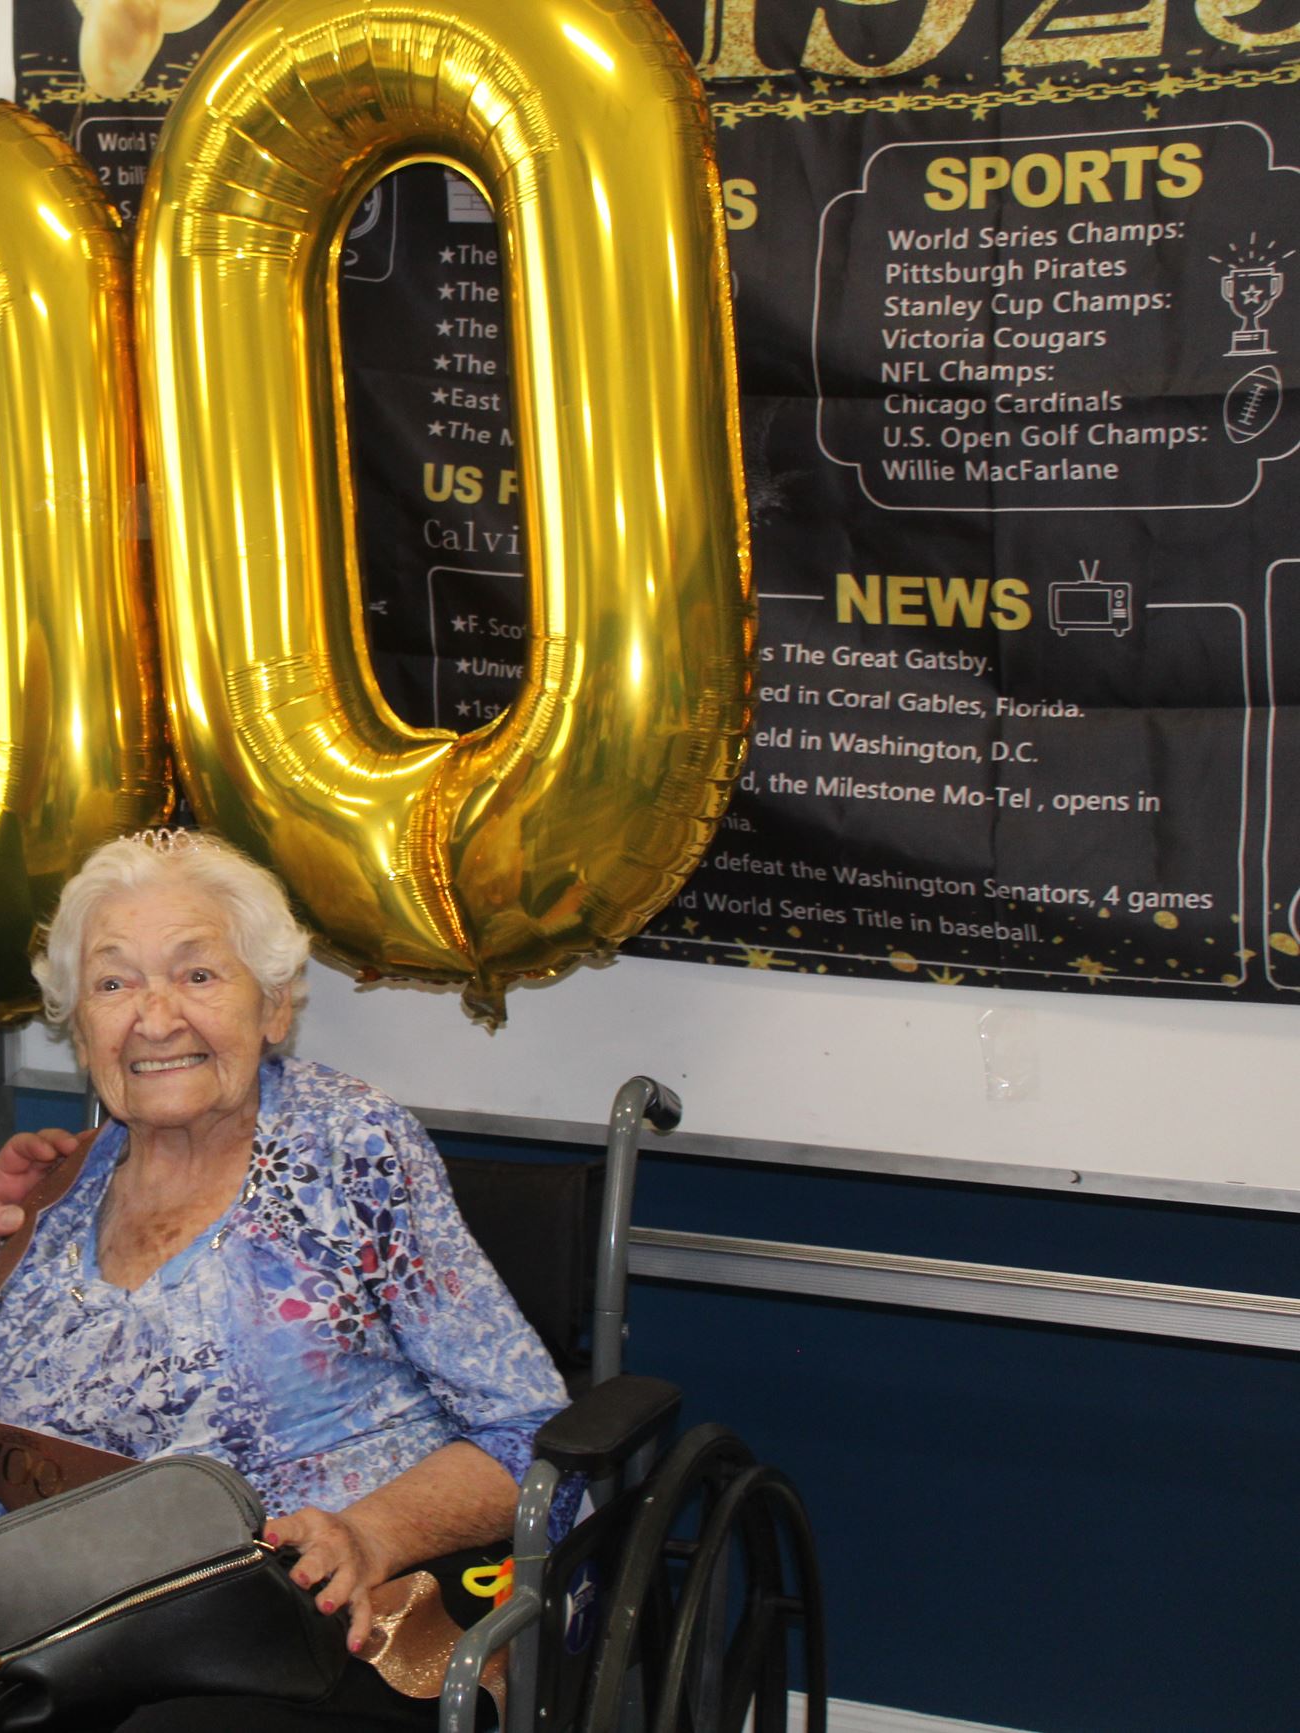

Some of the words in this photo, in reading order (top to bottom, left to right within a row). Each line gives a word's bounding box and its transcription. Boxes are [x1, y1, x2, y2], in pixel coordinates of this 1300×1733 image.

[97, 132, 147, 152] World
[924, 143, 1203, 211] SPORTS
[887, 227, 969, 251] World
[978, 225, 1058, 249] Series
[1067, 219, 1185, 247] Champs:
[457, 245, 498, 266] The
[885, 261, 1024, 287] Pittsburgh
[1034, 258, 1128, 281] Pirates
[457, 281, 500, 303] The
[883, 295, 983, 322] Stanley
[991, 293, 1044, 320] Cup
[1052, 290, 1172, 319] Champs:
[455, 317, 499, 339] The
[881, 328, 985, 350] Victoria
[993, 327, 1107, 353] Cougars
[453, 353, 497, 375] The
[880, 361, 931, 383] NFL
[939, 360, 1055, 387] Champs:
[450, 388, 501, 412] East
[883, 393, 987, 420] Chicago
[994, 390, 1123, 415] Cardinals
[447, 420, 492, 444] The
[882, 426, 931, 448] U.S.
[940, 426, 1011, 453] Open
[1020, 424, 1079, 448] Golf
[1087, 423, 1209, 450] Champs:
[422, 462, 483, 505] US
[881, 459, 956, 482] Willie
[964, 459, 1120, 482] MacFarlane
[835, 572, 1033, 632] NEWS
[488, 617, 527, 640] Sco
[781, 643, 826, 666] The
[831, 645, 899, 669] Great
[904, 649, 995, 677] Gatsby.
[798, 685, 820, 705] in
[826, 688, 891, 710] Coral
[897, 692, 988, 719] Gables,
[995, 697, 1086, 719] Florida.
[754, 726, 793, 748] eld
[800, 729, 822, 751] in
[829, 732, 984, 765] Washington,
[990, 741, 1039, 764] D.C.
[768, 772, 809, 796] the
[815, 775, 937, 804] Milestone
[1052, 793, 1130, 816] opens
[1136, 790, 1161, 814] in
[714, 850, 785, 877] defeat
[791, 857, 828, 882] the
[832, 865, 977, 898] Washington
[982, 877, 1097, 909] Senators,
[1102, 885, 1120, 907] 4
[1127, 889, 1215, 914] games
[703, 891, 773, 917] World
[779, 900, 848, 925] Series
[851, 907, 903, 931] Title
[909, 912, 933, 934] in
[939, 914, 1046, 944] baseball.
